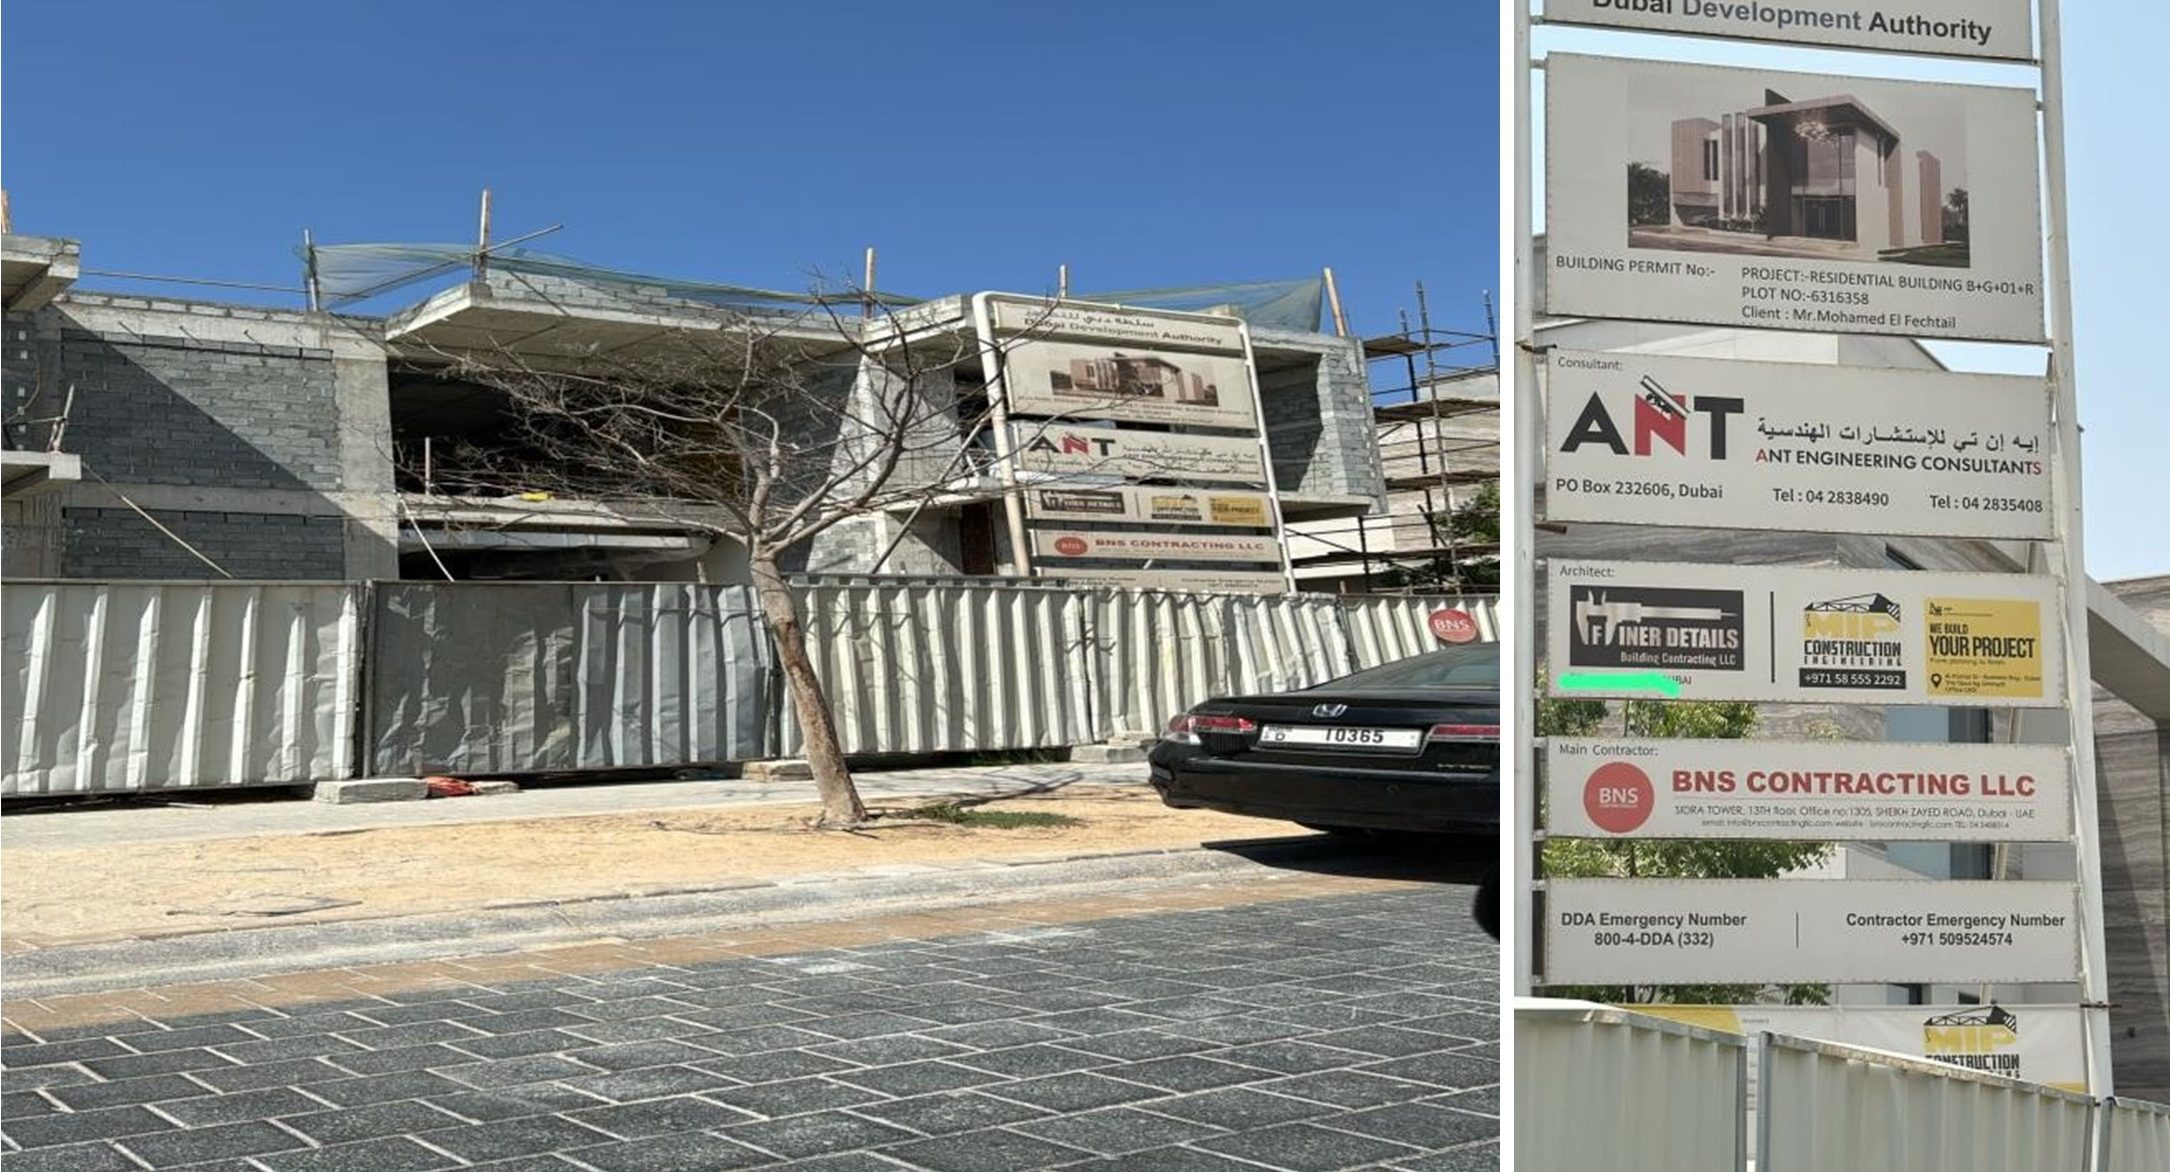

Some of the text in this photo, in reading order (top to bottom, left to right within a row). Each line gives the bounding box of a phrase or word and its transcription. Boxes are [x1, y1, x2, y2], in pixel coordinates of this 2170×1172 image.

[1682, 0, 1861, 32] Development
[1868, 12, 1992, 46] Authority
[1556, 255, 1716, 277] BUILDING PERMIT No:-
[1741, 267, 2034, 296] PROJECT:-RESIDENTIAL BUILDING B+G+01+R
[1741, 286, 1869, 305] PLOT NO:-6316358
[1741, 304, 1781, 320] Client
[1792, 308, 1886, 326] Mr.Mohamed
[1889, 314, 1901, 326] El
[1903, 315, 1957, 329] Fechtail
[1162, 331, 1222, 345] Authority
[1557, 356, 1623, 371] Consultant:
[1560, 390, 1744, 460] ANT
[1028, 436, 1116, 457] ANT
[1755, 448, 2042, 475] ANT ENGINEERING CONSULTANTS
[1556, 479, 1723, 500] PO Box 232606, Dubai
[1773, 488, 1794, 502] Tel
[1805, 490, 1823, 503] 04
[1827, 490, 1889, 506] 2838490
[1930, 494, 1951, 509] Tel
[1962, 496, 1980, 510] 04
[1983, 496, 2043, 512] 2835408
[1095, 539, 1126, 548] BNS
[1238, 542, 1265, 550] LLC
[1559, 565, 1616, 578] Architect:
[1434, 619, 1470, 631] BNS
[1929, 623, 1968, 635] WE BUILD
[1666, 626, 1739, 650] DETAILS
[1929, 635, 2035, 658] YOUR PROJECT
[1804, 639, 1901, 658] CONSTRUCTION
[1621, 650, 1736, 668] Building Contracting LLC
[1804, 673, 1902, 686] +971 58 555 2292
[1325, 728, 1385, 744] 10365
[1559, 744, 1659, 757] Main Contractor:
[1672, 770, 2036, 797] BNS CONTRACTING LLC
[1599, 787, 1638, 804] BNS
[1911, 807, 1940, 817] ZAYED
[1560, 913, 1746, 930] DDA Emergency Number
[1846, 913, 2065, 930] Contractor Emergency Number
[1594, 932, 1715, 949] 800-4-DDA (332)
[1901, 932, 2014, 946] +971 509524574
